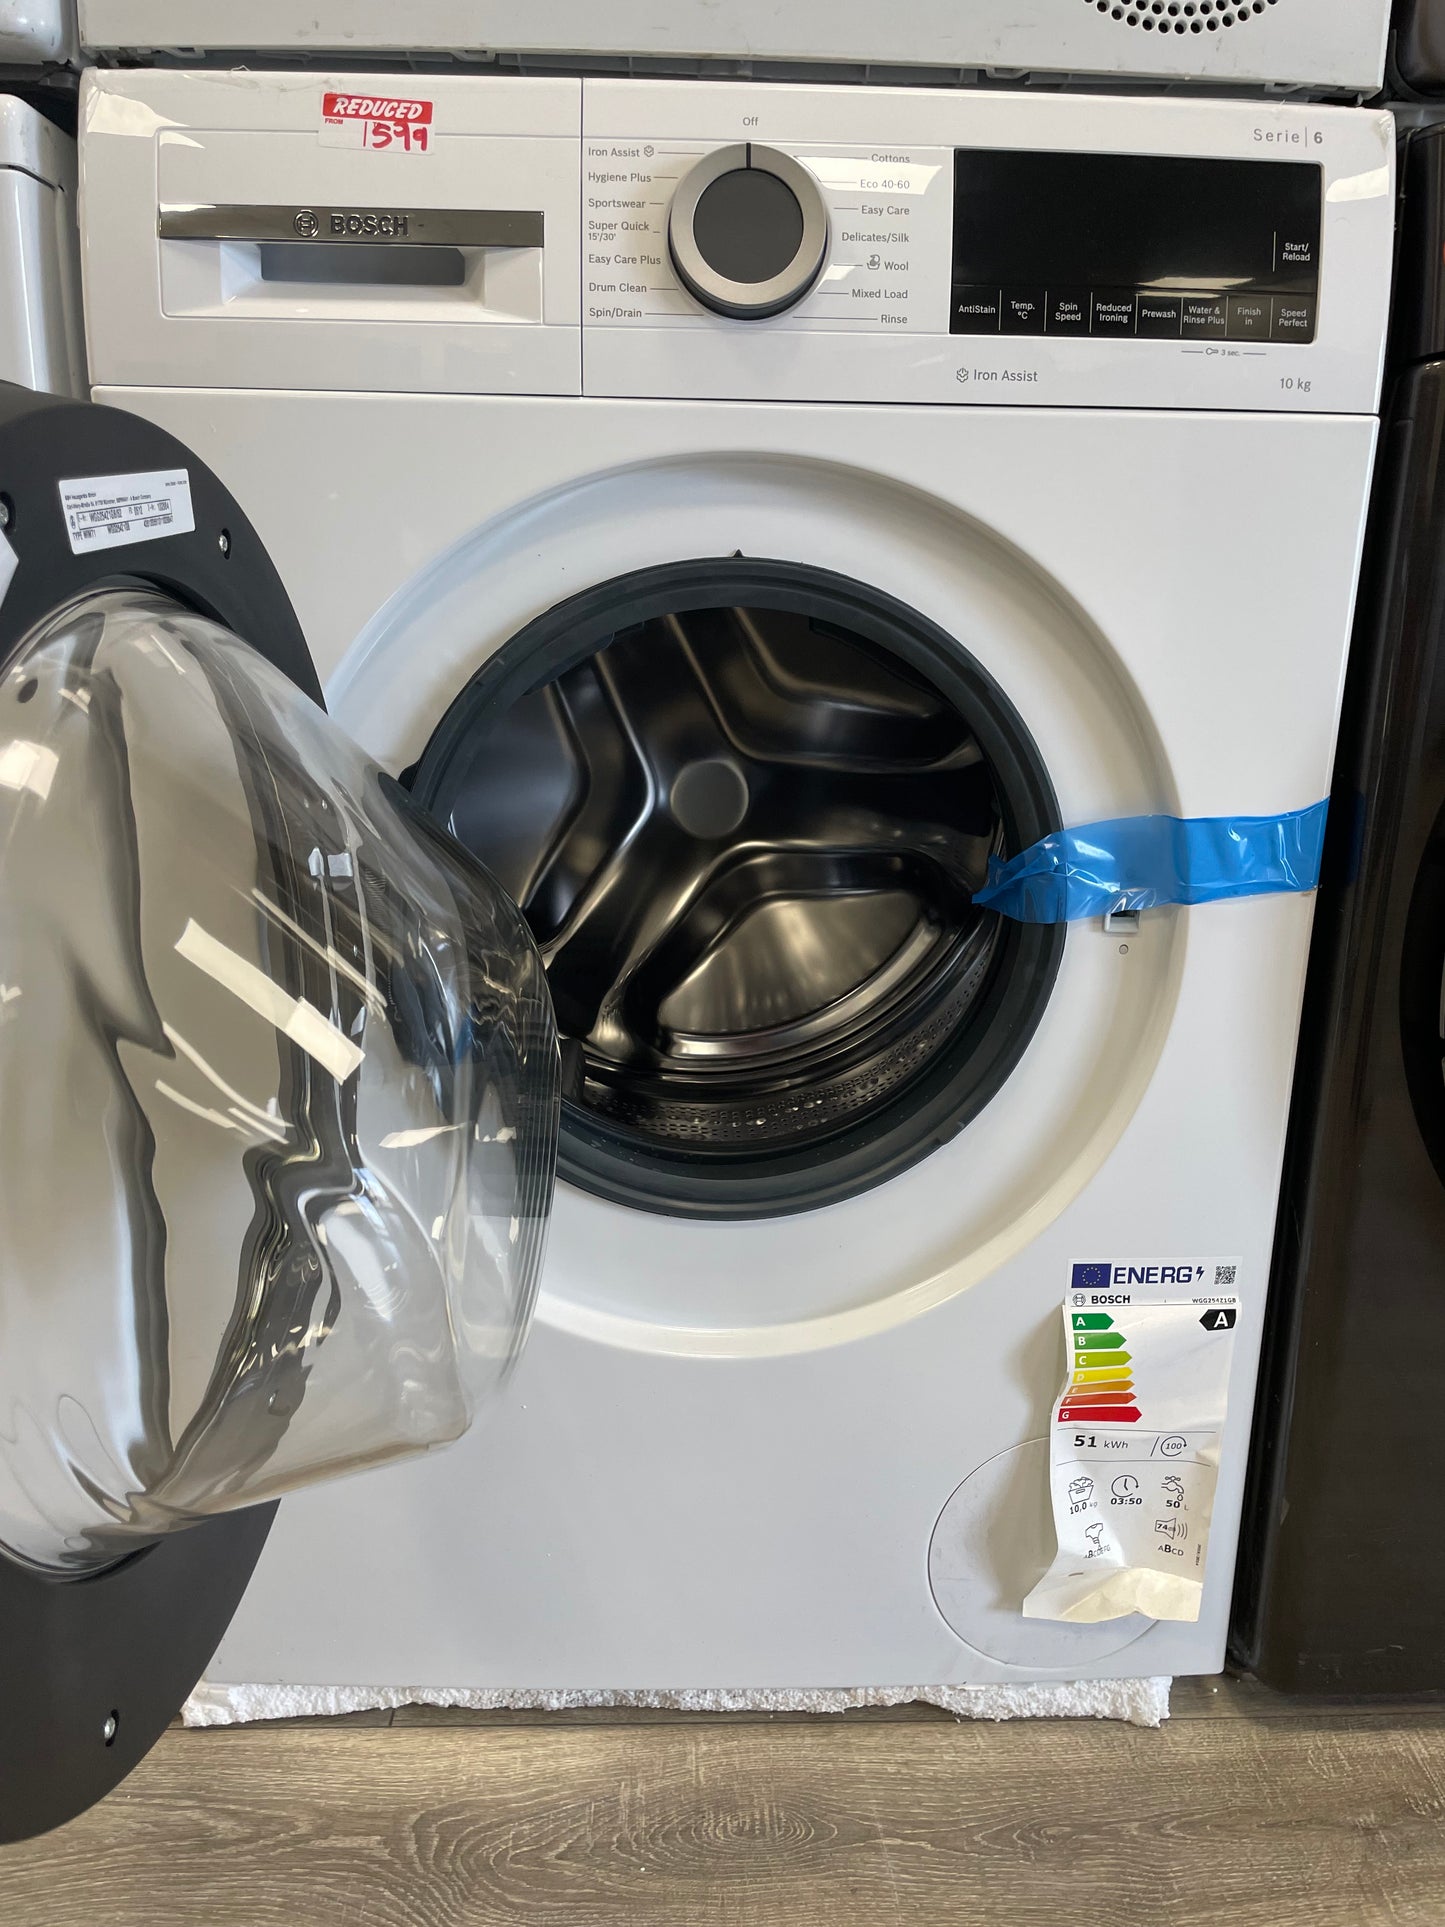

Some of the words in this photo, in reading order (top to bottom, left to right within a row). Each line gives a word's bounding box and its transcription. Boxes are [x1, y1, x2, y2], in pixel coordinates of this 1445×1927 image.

[332, 97, 423, 119] REDUCED
[742, 117, 758, 126] Off
[1253, 128, 1300, 143] Serie
[1313, 131, 1323, 144] 6
[588, 147, 608, 157] Iron
[611, 147, 640, 157] Assist
[871, 153, 910, 163] Cottons
[588, 172, 627, 183] Hygiene
[630, 173, 651, 183] Plus
[860, 179, 878, 189] Eco
[881, 180, 910, 189] 40-60
[588, 198, 646, 210] Sportswear
[861, 205, 884, 216] Easy
[886, 206, 910, 215] Care
[330, 213, 409, 237] BOSCH
[588, 220, 618, 232] Super
[621, 221, 650, 231] Quick
[841, 232, 910, 243] Delicates/Silk
[588, 254, 611, 266] Easy
[614, 255, 637, 264] Care
[640, 255, 661, 265] Plus
[1282, 252, 1311, 262] Reload
[884, 261, 909, 271] Wool
[589, 282, 616, 292] Drum
[619, 283, 647, 293] Clean
[851, 289, 881, 299] Mixed
[884, 290, 908, 299] Load
[958, 305, 996, 314] AntiStain
[1010, 301, 1035, 311] Temp.
[1059, 302, 1078, 313] Spin
[1096, 303, 1132, 312] Reduced
[1188, 305, 1212, 315] Water
[1214, 306, 1220, 315] &
[1237, 306, 1261, 315] Finish
[589, 307, 642, 318] Spin/Drain
[1055, 312, 1082, 322] Speed
[1142, 309, 1177, 319] Prewash
[1281, 308, 1307, 318] Speed
[881, 314, 908, 324] Rinse
[1099, 313, 1128, 324] Ironing
[1183, 315, 1206, 324] Rinse
[1207, 316, 1225, 325] Plus
[1245, 317, 1253, 325] in
[1278, 318, 1308, 328] Perfect
[973, 369, 997, 381] Iron
[1001, 370, 1038, 382] Assist
[1280, 378, 1293, 389] 10
[1297, 378, 1311, 393] kg
[1091, 1295, 1131, 1304] BOSCH
[1076, 1317, 1086, 1327] A
[1213, 1311, 1229, 1328] A
[1078, 1336, 1086, 1346] B
[1078, 1355, 1087, 1365] C
[1076, 1373, 1085, 1382] D
[1061, 1411, 1070, 1420] G
[1073, 1434, 1097, 1448] 51
[1103, 1440, 1128, 1449] kWh
[1165, 1442, 1182, 1450] 100
[1110, 1497, 1143, 1505] 03:50
[1165, 1499, 1181, 1509] 50
[1069, 1501, 1087, 1515] 10,0
[1156, 1523, 1168, 1531] 74
[1157, 1544, 1184, 1557] ABCD
